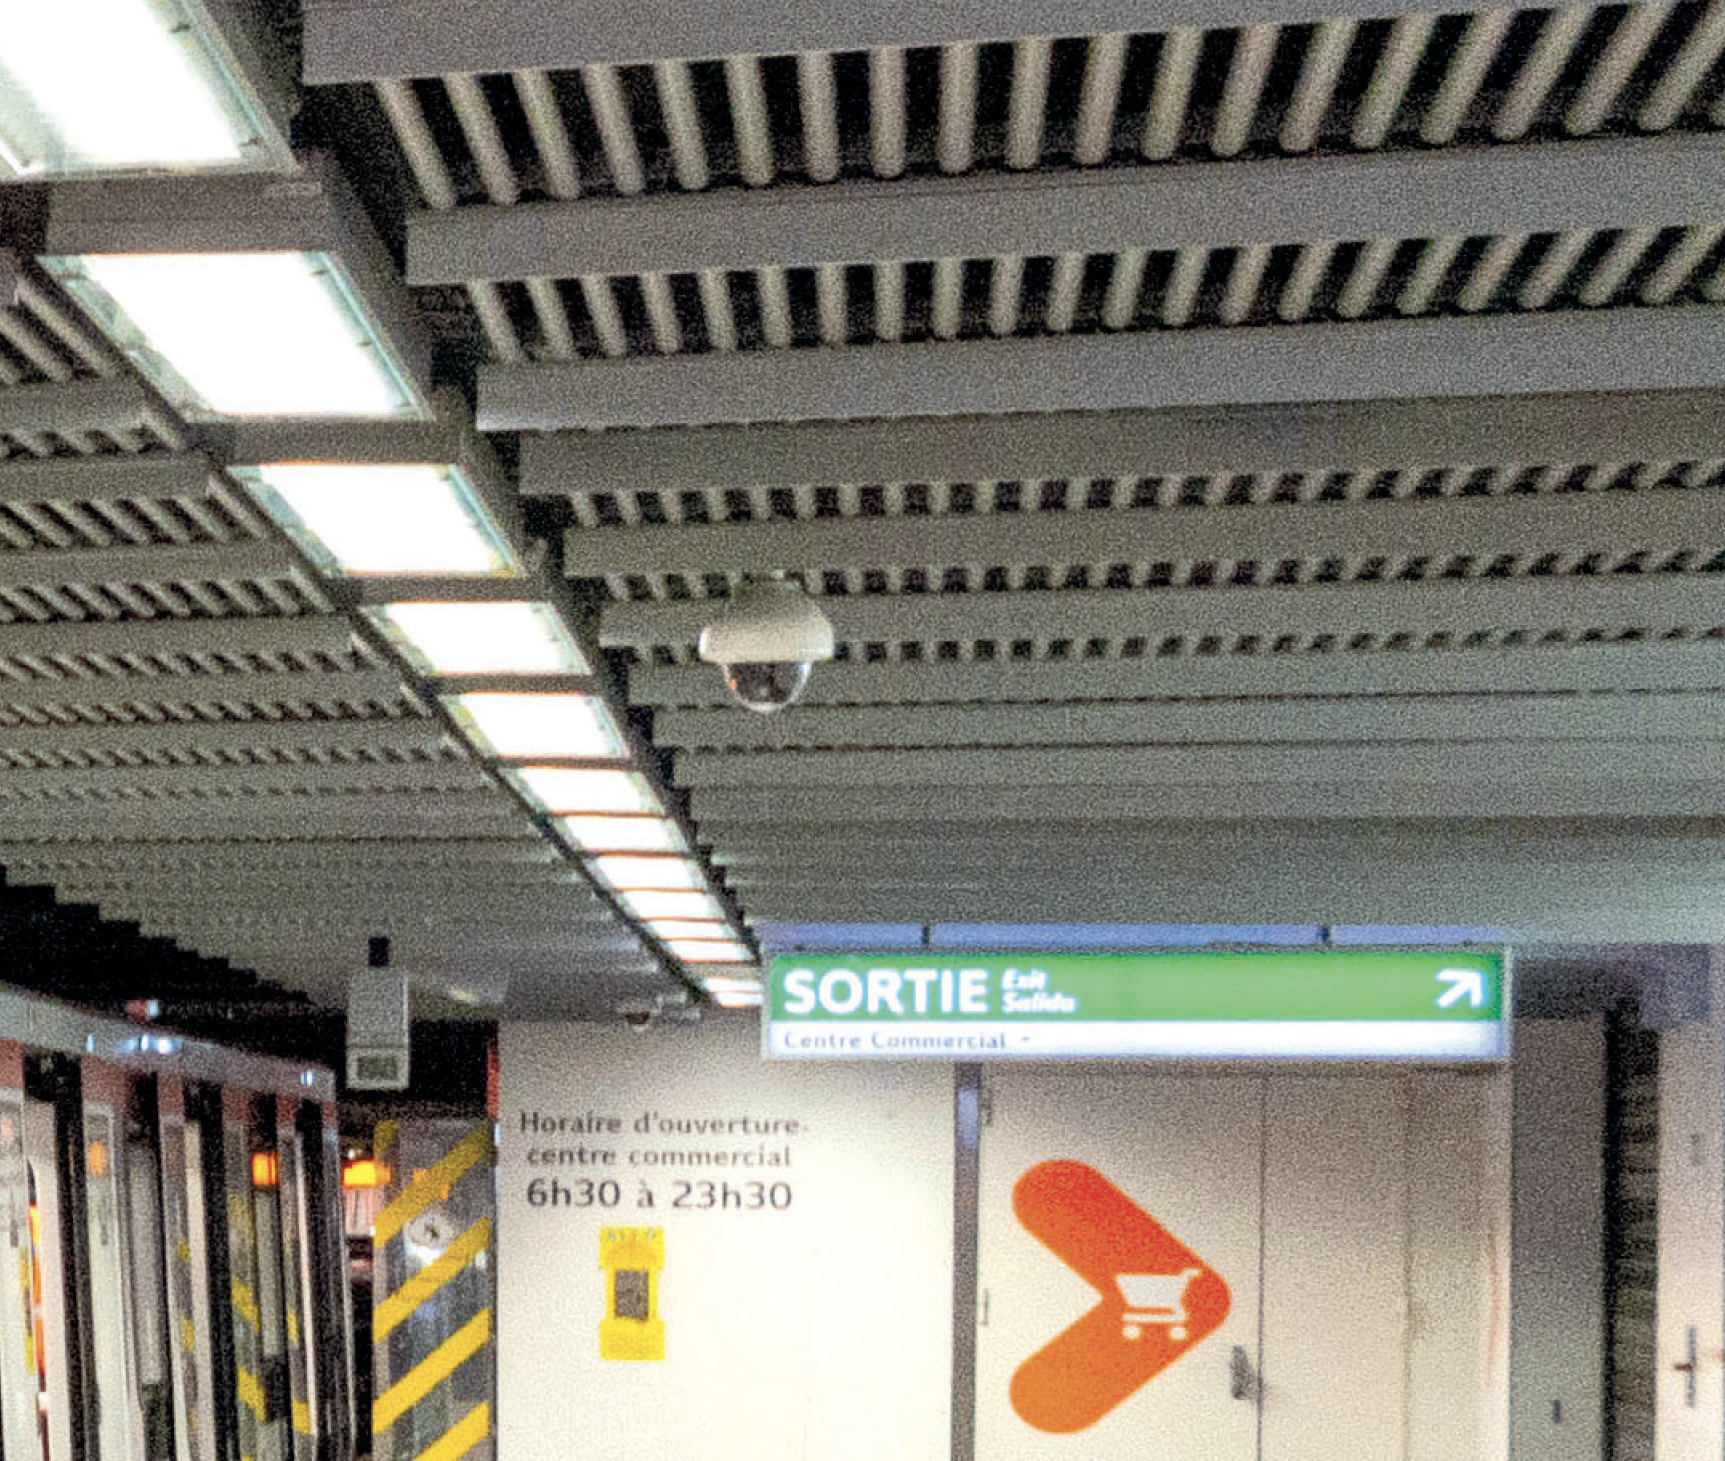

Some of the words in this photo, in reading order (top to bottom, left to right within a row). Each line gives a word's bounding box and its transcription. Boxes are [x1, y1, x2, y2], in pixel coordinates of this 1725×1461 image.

[783, 967, 989, 1014] SORTIE
[1002, 967, 1047, 990] Exit
[1002, 991, 1077, 1014] Salida
[783, 1031, 861, 1050] Centre
[871, 1031, 1006, 1050] Commercial
[519, 1110, 623, 1135] Horaire
[633, 1110, 801, 1136] d'ouverture
[526, 1146, 617, 1167] centre
[628, 1144, 793, 1168] commercial
[526, 1177, 621, 1208] 6h30
[636, 1178, 654, 1208] à
[671, 1179, 793, 1211] 23h30
